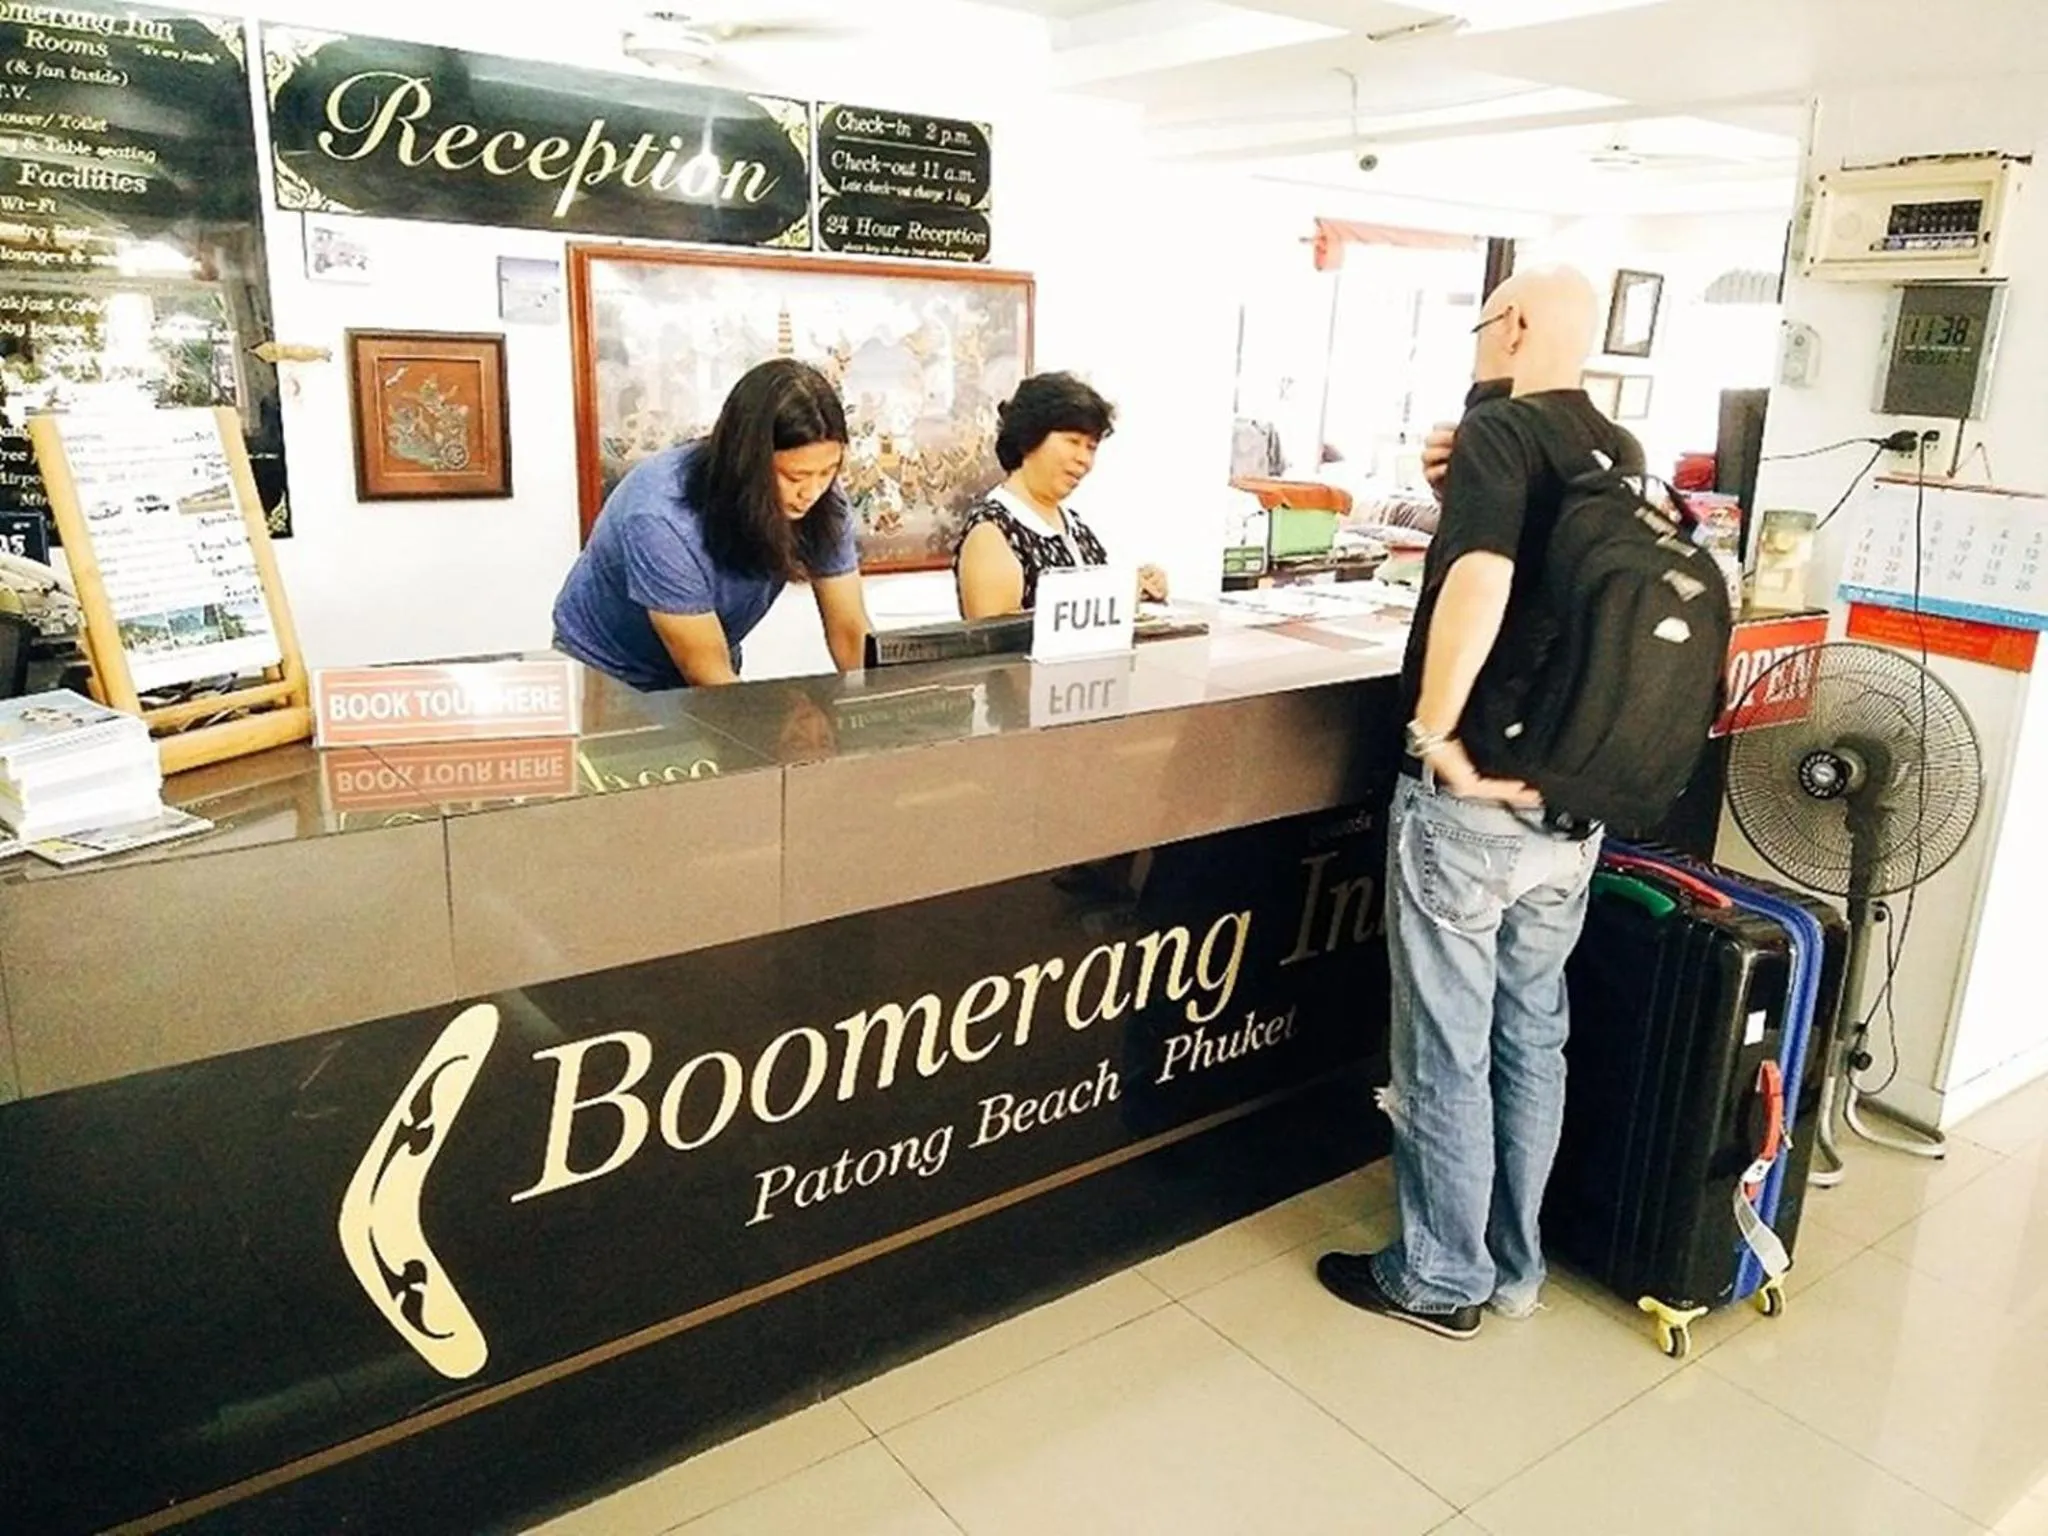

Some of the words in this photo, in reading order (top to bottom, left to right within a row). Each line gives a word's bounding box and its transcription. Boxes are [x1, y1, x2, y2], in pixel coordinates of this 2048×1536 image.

[25, 29, 109, 57] Rooms
[35, 61, 66, 80] fan
[835, 109, 911, 138] Check-in
[926, 122, 937, 141] 2
[317, 71, 781, 218] Reception
[17, 162, 148, 194] Facilities
[831, 150, 917, 178] Check-out
[922, 160, 939, 179] 11
[825, 215, 850, 236] 24
[855, 216, 901, 238] Hour
[907, 220, 987, 247] Reception
[0, 472, 40, 489] Airpo
[1053, 596, 1121, 632] FULL
[1727, 644, 1818, 711] OPEN
[329, 692, 412, 722] BOOK
[414, 689, 488, 719] TOU
[504, 684, 563, 714] HERE
[509, 908, 1252, 1203] Boomerang
[1279, 850, 1387, 966] In
[744, 1124, 953, 1226] Patong
[968, 1062, 1121, 1149] Beach
[1153, 1005, 1297, 1085] Phuket
